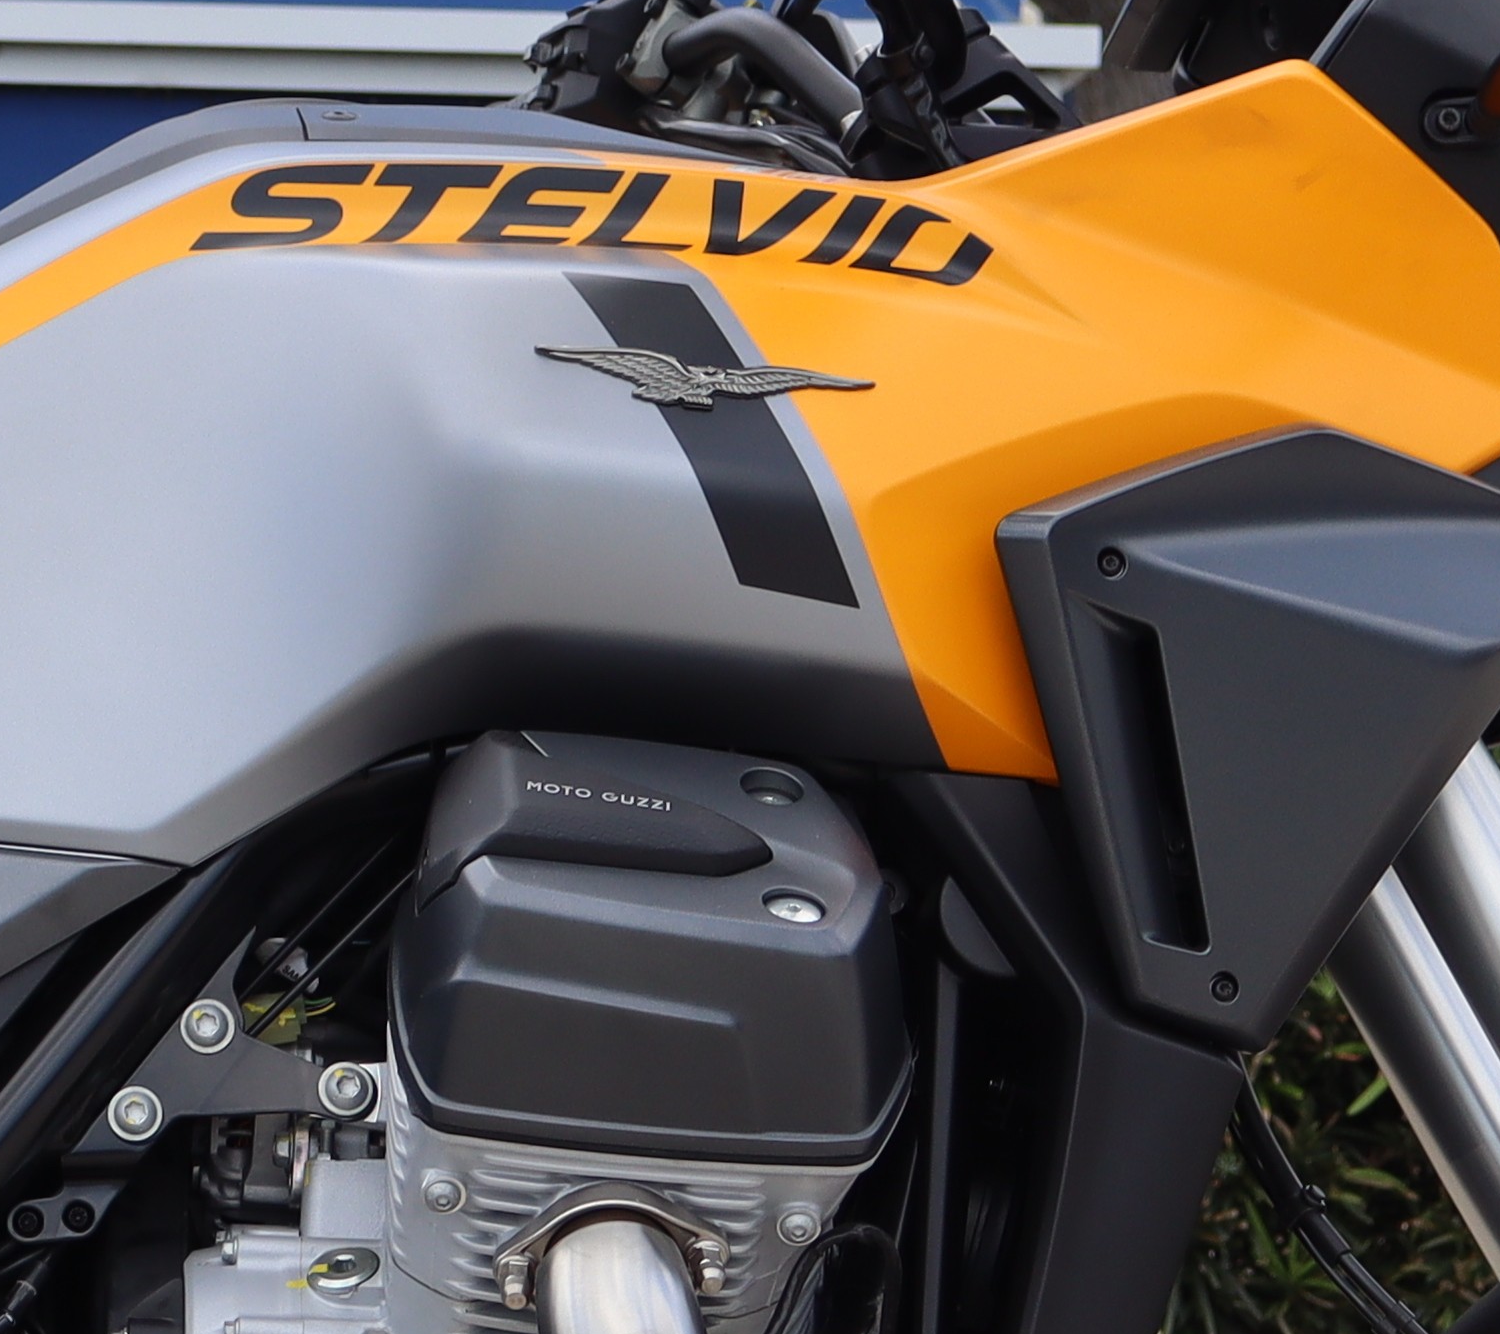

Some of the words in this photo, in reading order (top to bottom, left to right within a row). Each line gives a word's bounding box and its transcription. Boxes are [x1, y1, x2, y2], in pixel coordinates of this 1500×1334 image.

[191, 164, 994, 286] STELVIO
[526, 780, 592, 799] MOTO
[601, 791, 671, 812] GUZZI
